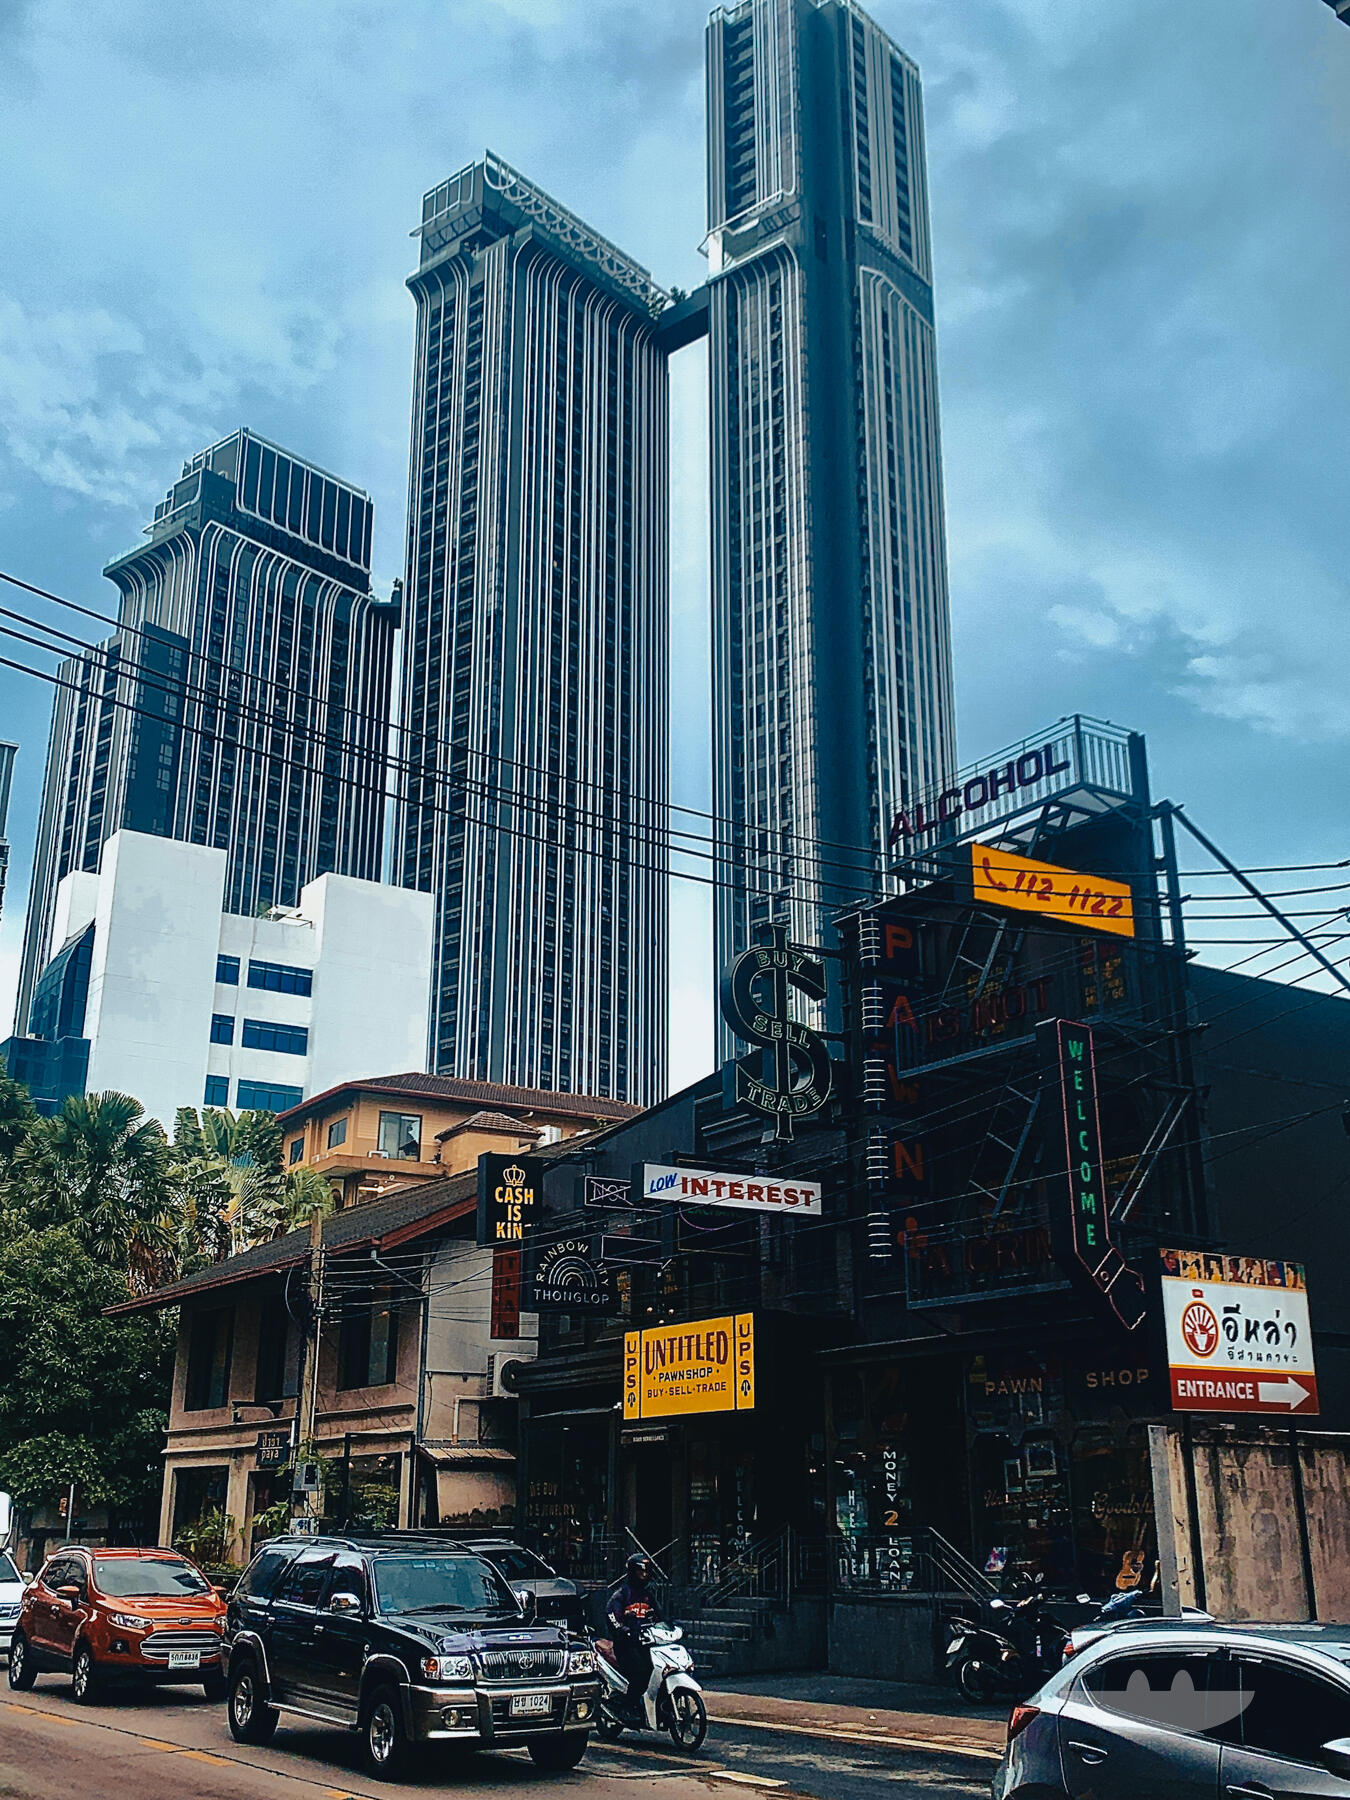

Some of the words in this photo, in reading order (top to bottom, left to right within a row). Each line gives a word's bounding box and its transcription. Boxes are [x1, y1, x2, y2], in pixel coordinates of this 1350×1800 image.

[889, 744, 1070, 847] ALCOHOL
[757, 951, 805, 971] BUY
[753, 1014, 811, 1048] SELL
[747, 1083, 821, 1112] TRADE
[1067, 1040, 1097, 1247] WELCOME
[494, 1186, 534, 1205] CASH
[650, 1173, 678, 1193] LOW
[681, 1176, 815, 1207] INTEREST
[507, 1204, 522, 1222] IS
[496, 1221, 522, 1240] KIN
[536, 1241, 589, 1282] RAINBOW
[1222, 1303, 1297, 1348] อีหล่า
[626, 1340, 637, 1388] UPS
[645, 1331, 728, 1375] UNTITLED
[739, 1323, 751, 1375] UPS
[984, 1377, 1043, 1396] PAWN
[1085, 1368, 1150, 1389] SHOP
[1177, 1379, 1255, 1400] ENTRANCE
[261, 1450, 279, 1461] paya
[883, 1450, 897, 1502] MONEY
[883, 1510, 899, 1526] 2
[888, 1537, 901, 1581] LOAN
[530, 1695, 548, 1707] 1024
